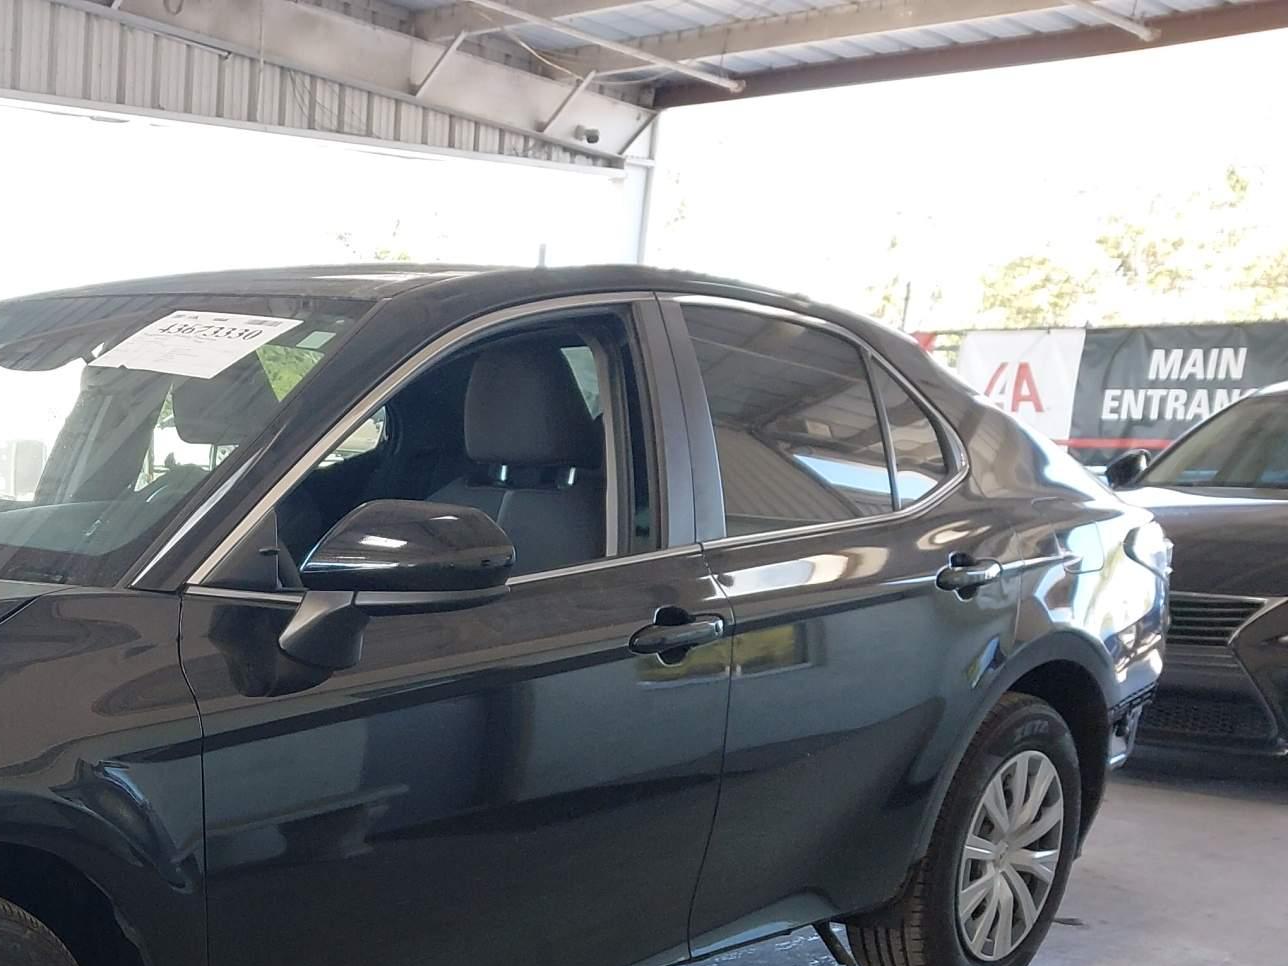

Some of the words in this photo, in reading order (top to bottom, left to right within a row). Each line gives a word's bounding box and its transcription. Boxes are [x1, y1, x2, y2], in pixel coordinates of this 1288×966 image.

[159, 322, 263, 340] 43673330
[1148, 348, 1248, 380] MAIN
[1101, 388, 1257, 420] ENTRAN
